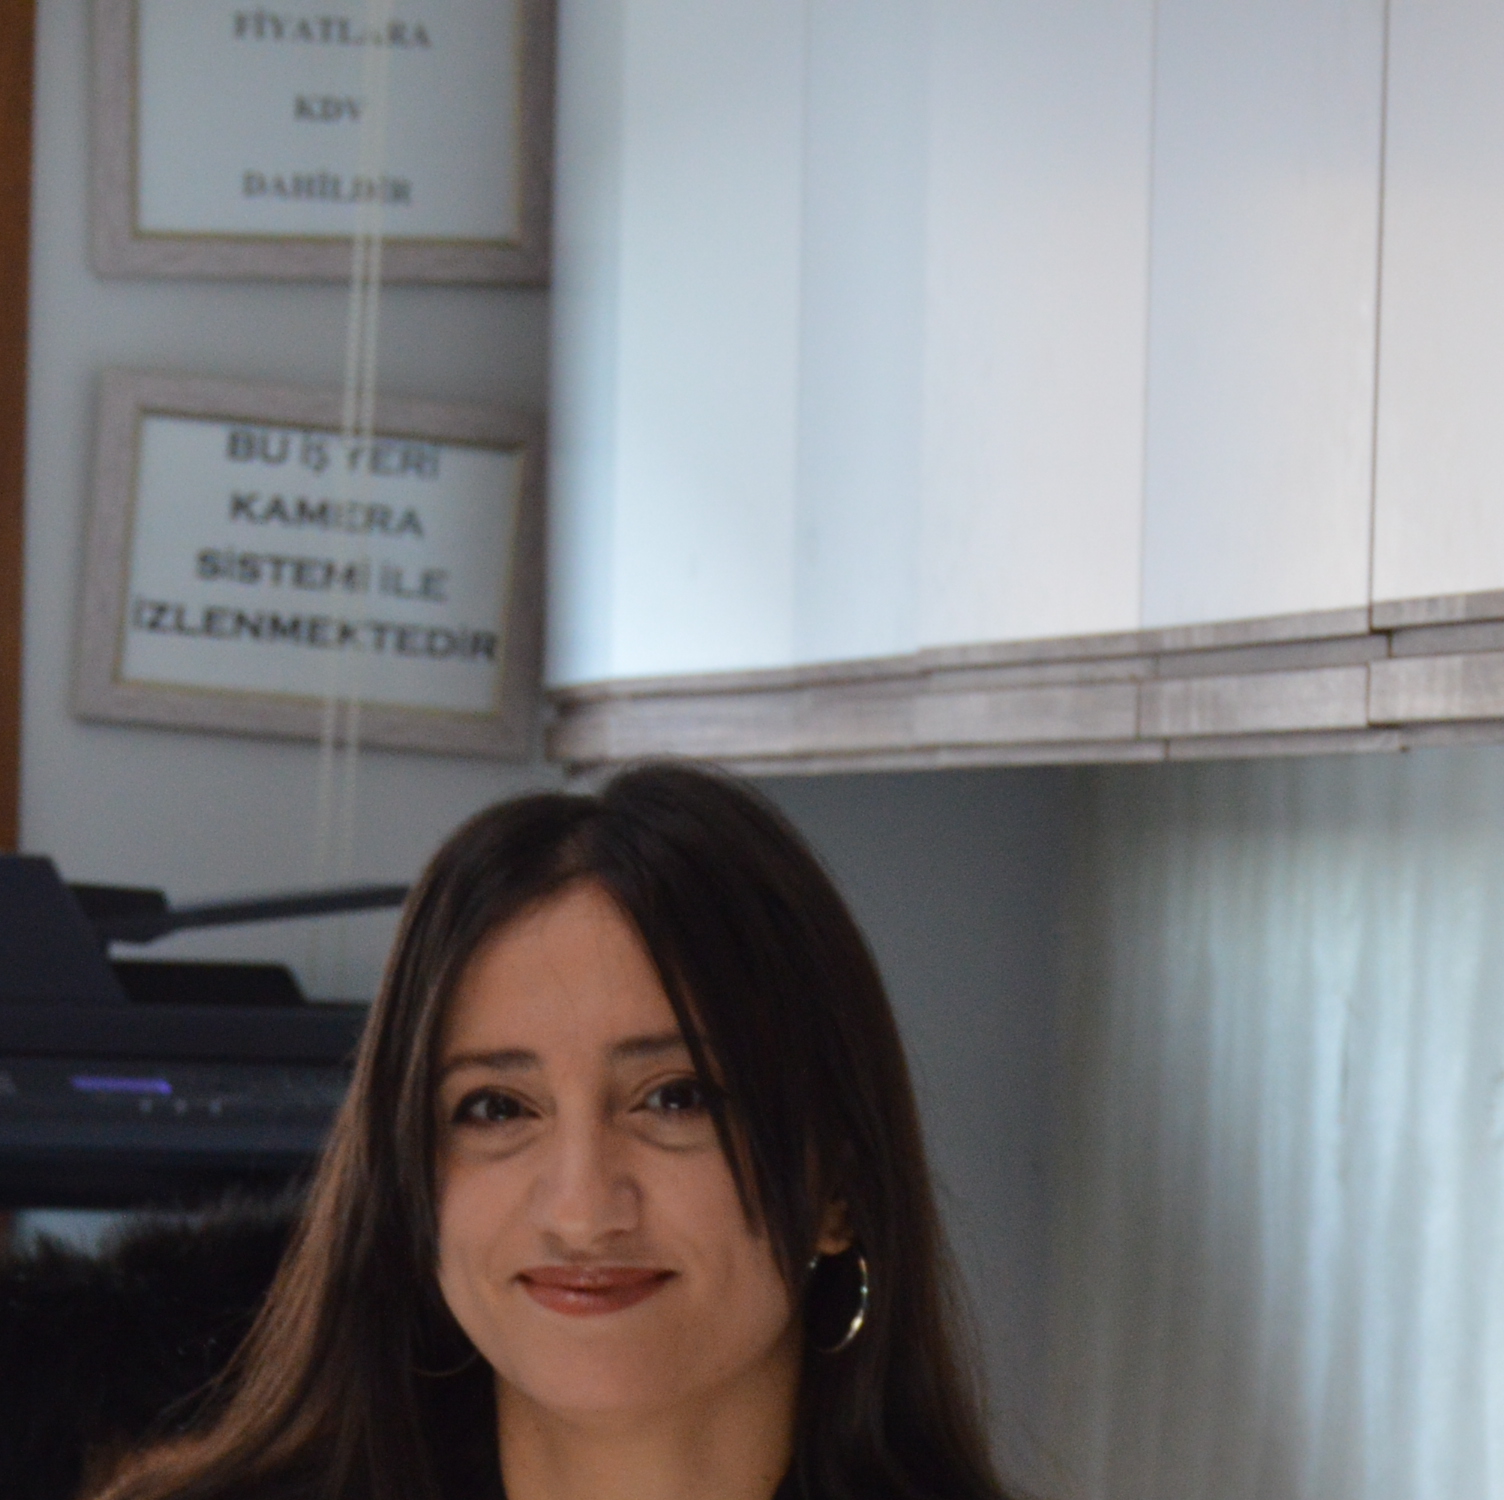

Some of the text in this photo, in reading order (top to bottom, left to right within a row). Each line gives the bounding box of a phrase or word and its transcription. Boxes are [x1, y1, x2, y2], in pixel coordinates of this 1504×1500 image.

[294, 94, 364, 123] KDV
[227, 428, 289, 464] BU
[229, 491, 425, 540] KAMERA
